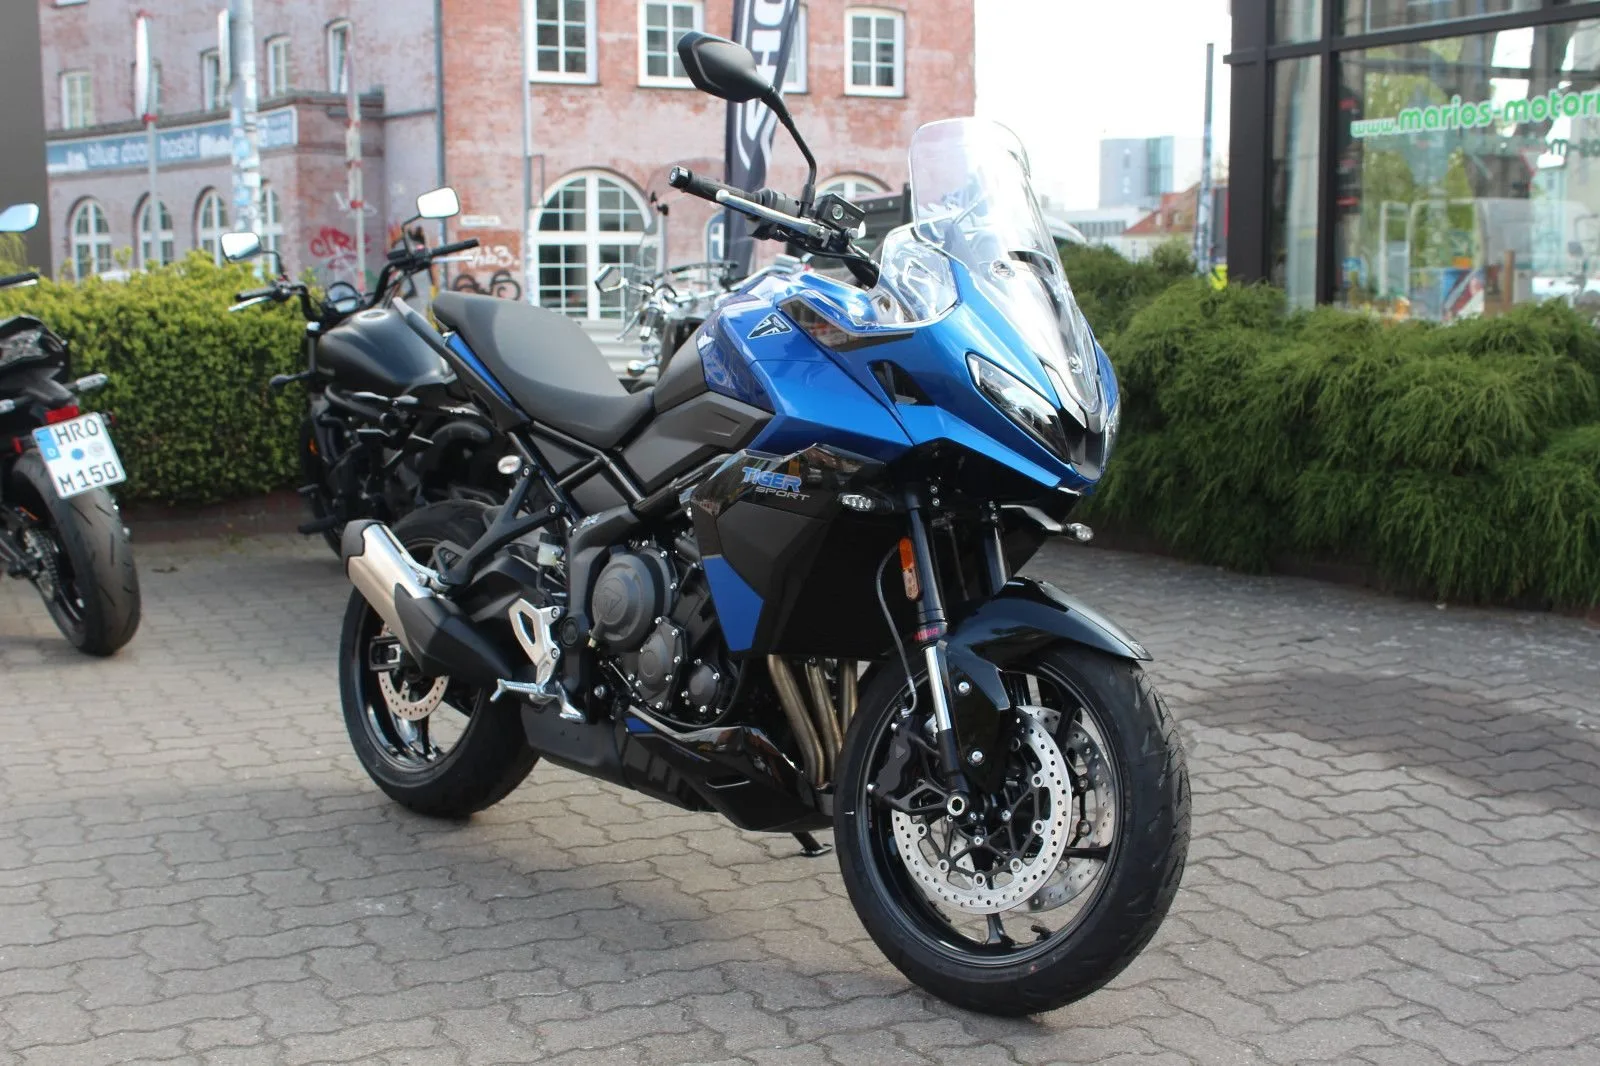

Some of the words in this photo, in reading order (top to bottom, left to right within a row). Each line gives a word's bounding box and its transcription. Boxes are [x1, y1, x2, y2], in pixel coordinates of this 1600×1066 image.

[1351, 90, 1600, 137] www.marios-motor
[54, 418, 99, 445] HRO
[742, 466, 802, 493] TIGER
[755, 486, 811, 501] SPORT
